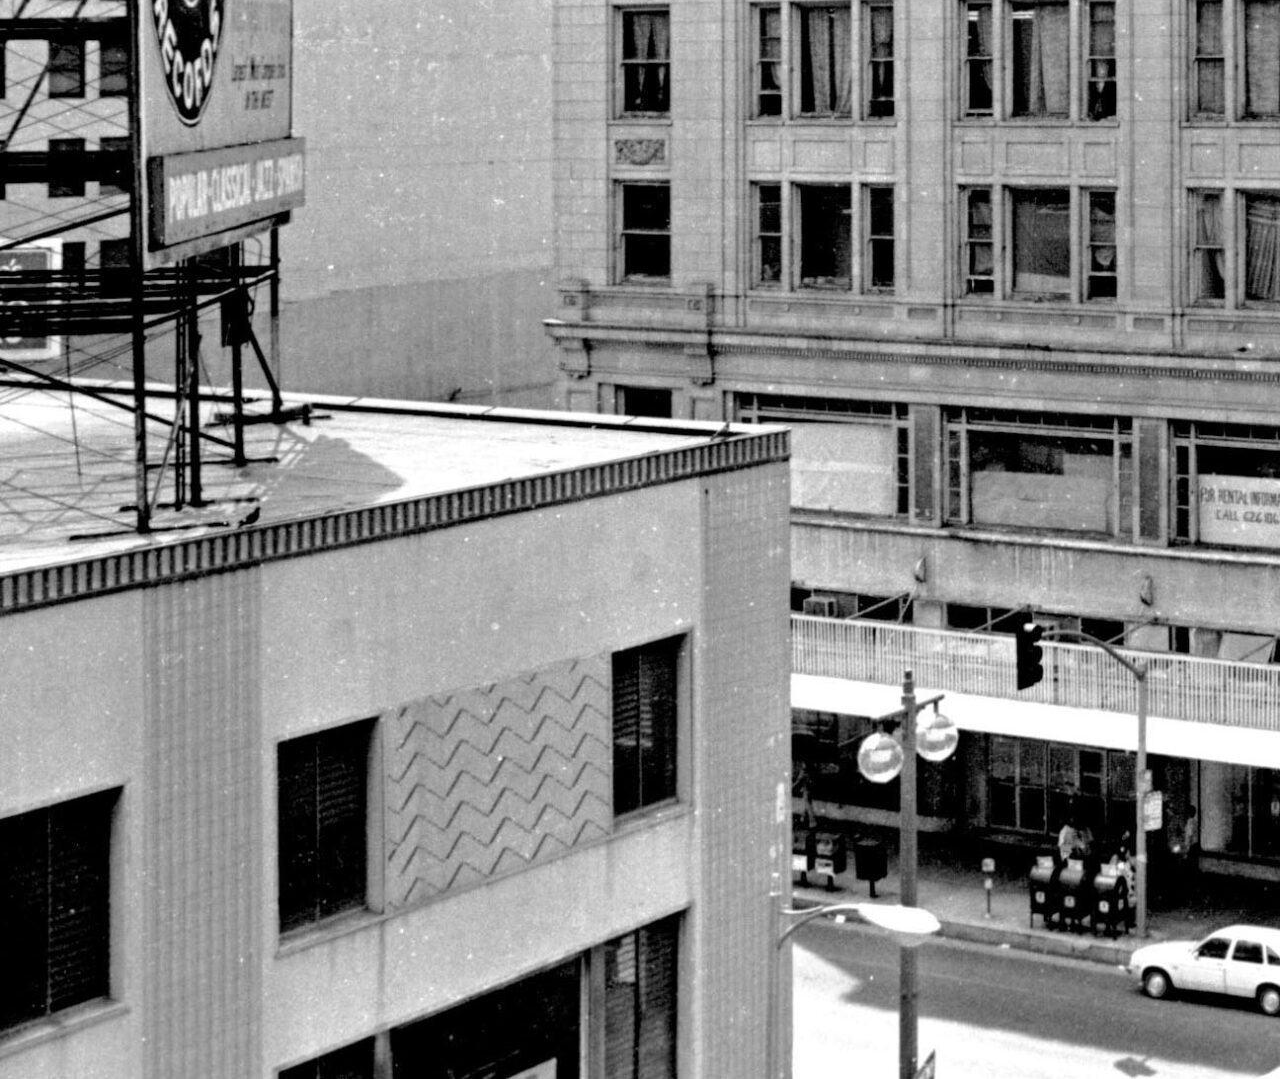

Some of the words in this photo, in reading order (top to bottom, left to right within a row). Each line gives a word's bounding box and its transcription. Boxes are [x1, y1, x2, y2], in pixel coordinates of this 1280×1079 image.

[1200, 485, 1216, 503] FOR
[1218, 488, 1249, 506] RENTAL
[1215, 508, 1240, 522] CALL
